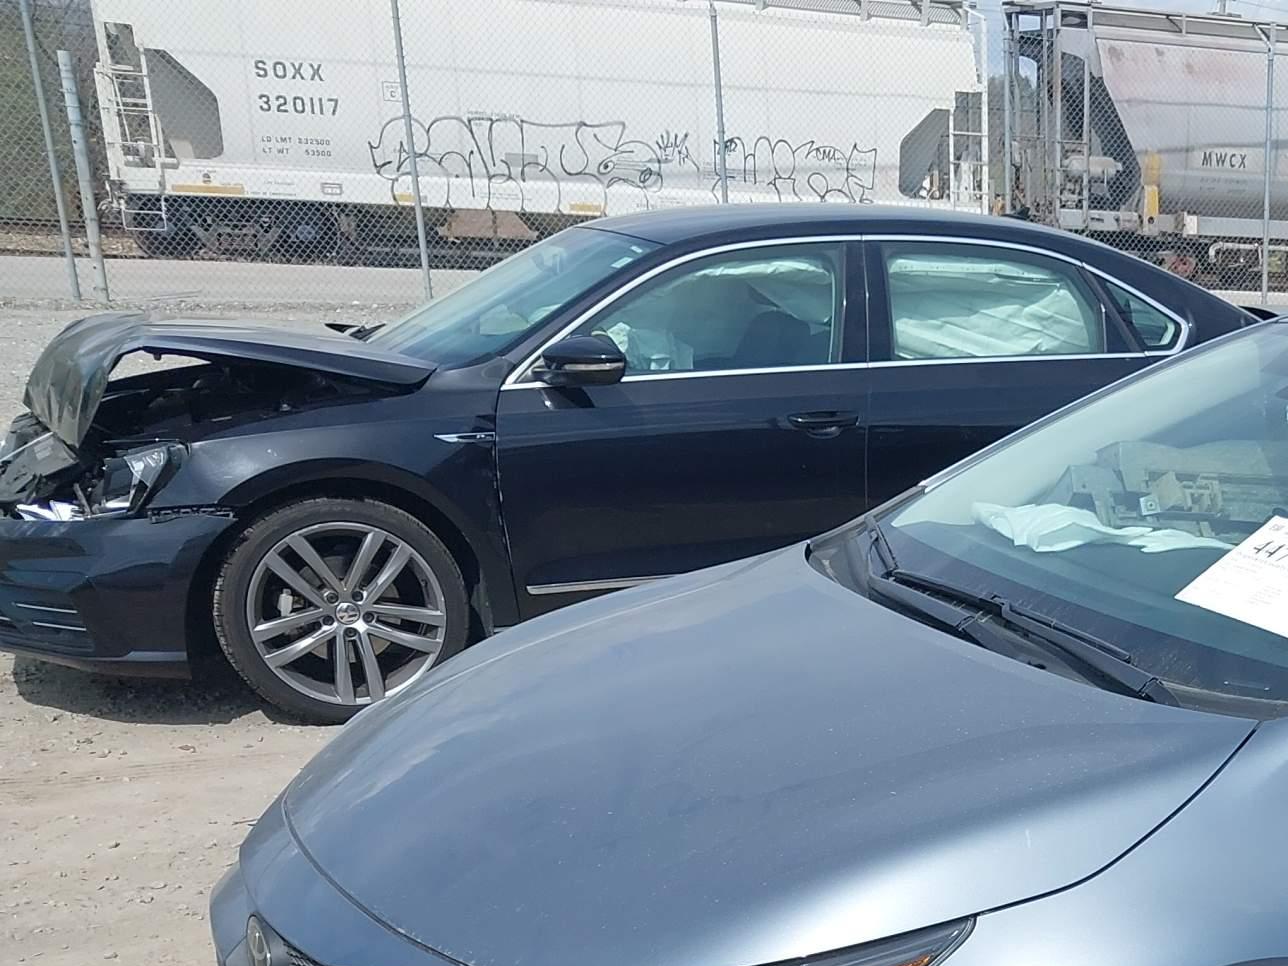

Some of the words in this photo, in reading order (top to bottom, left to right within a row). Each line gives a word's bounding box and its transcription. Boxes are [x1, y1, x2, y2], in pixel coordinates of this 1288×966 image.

[254, 59, 325, 82] SOXX
[258, 93, 339, 116] 320117
[1201, 151, 1248, 169] MWCX
